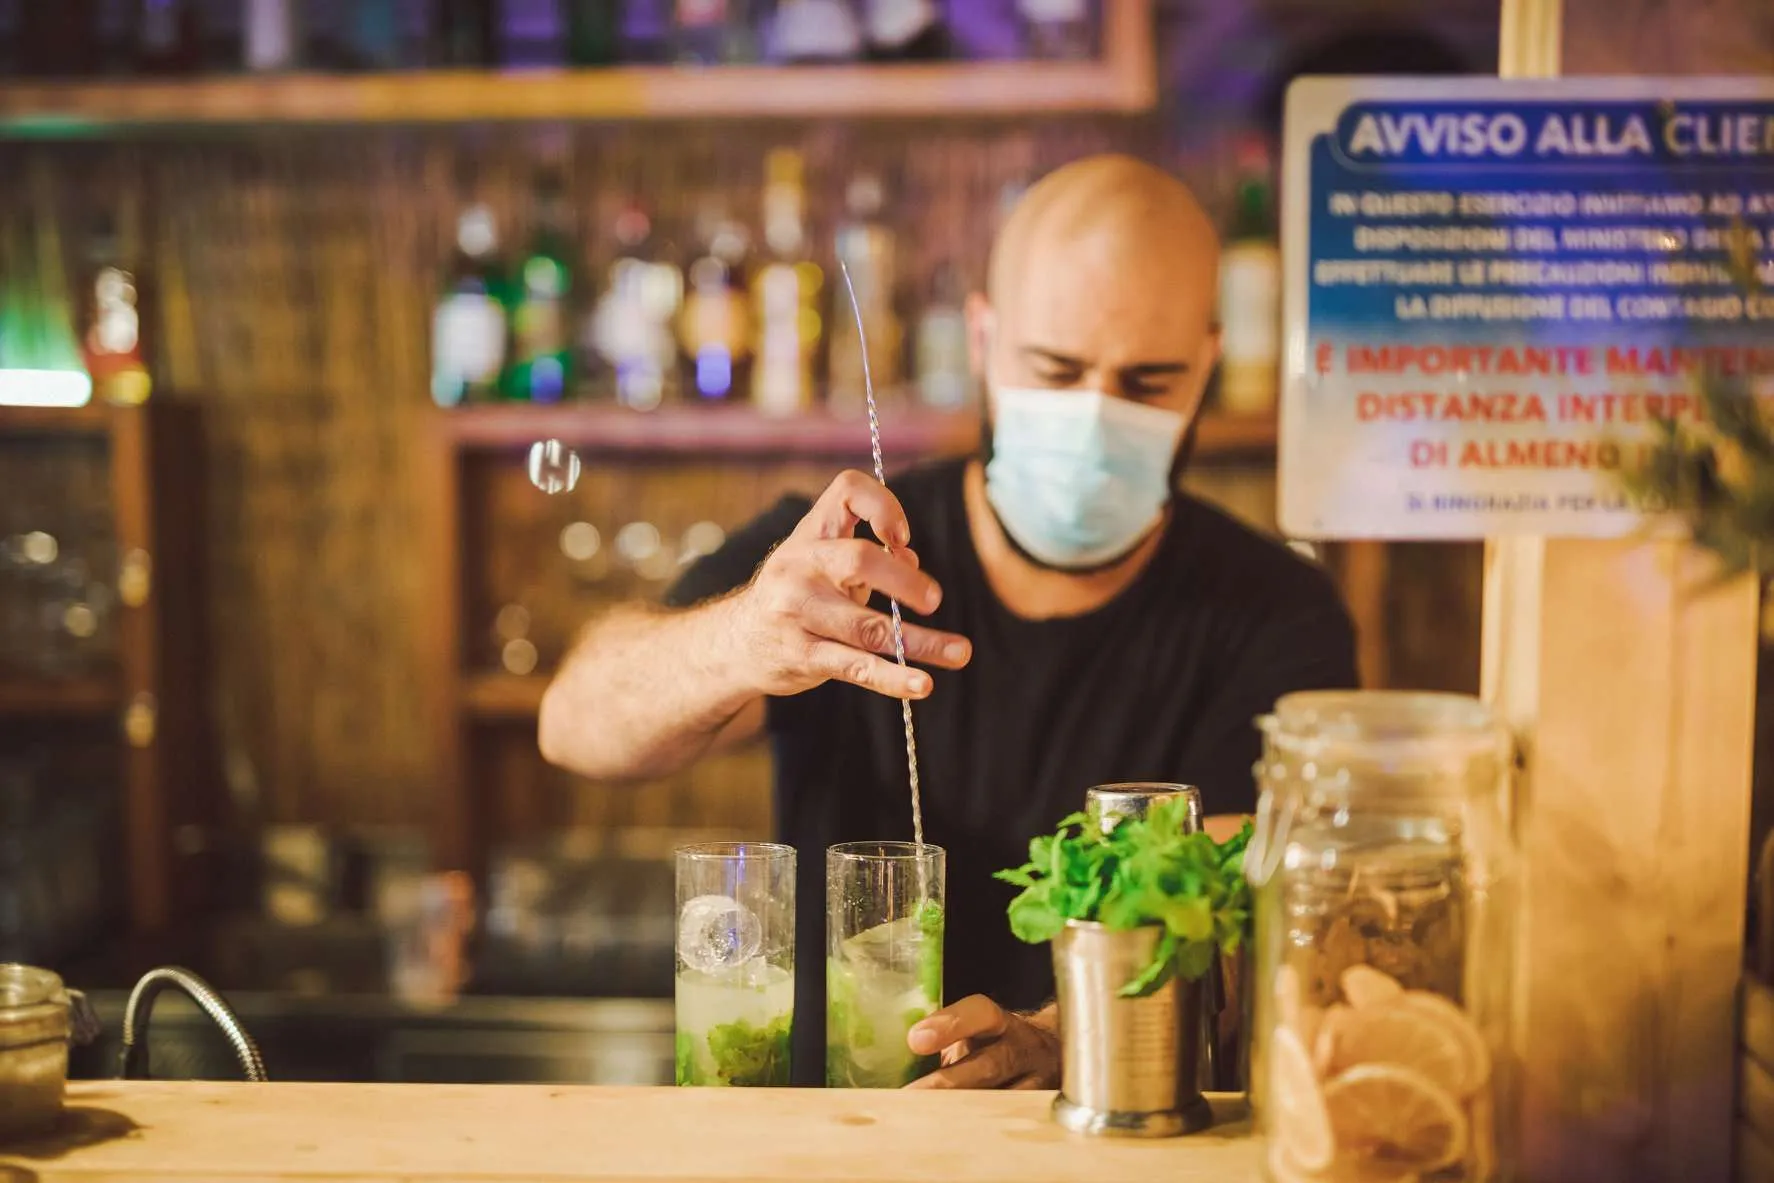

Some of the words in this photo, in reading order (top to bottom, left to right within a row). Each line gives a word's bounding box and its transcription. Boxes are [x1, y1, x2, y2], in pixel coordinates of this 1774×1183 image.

[1349, 113, 1527, 155] AVVISO
[1536, 113, 1653, 155] ALLA
[1329, 192, 1357, 216] IN
[1361, 191, 1454, 216] QUESTO
[1459, 191, 1576, 216] ESERCIZIO
[1354, 226, 1508, 251] DISPOSIZIONI
[1514, 226, 1556, 251] DEL
[1314, 260, 1453, 285] EFFETTUARE
[1458, 261, 1483, 285] LE
[1488, 260, 1640, 285] PRECAUZIONI
[1395, 295, 1428, 319] LA
[1430, 294, 1564, 319] DIFFUSIONE
[1569, 294, 1613, 319] DEL
[1346, 345, 1594, 375] IMPORTANTE
[1357, 391, 1546, 423] DISTANZA
[1410, 439, 1448, 469] DI
[1459, 439, 1621, 470] ALMENO
